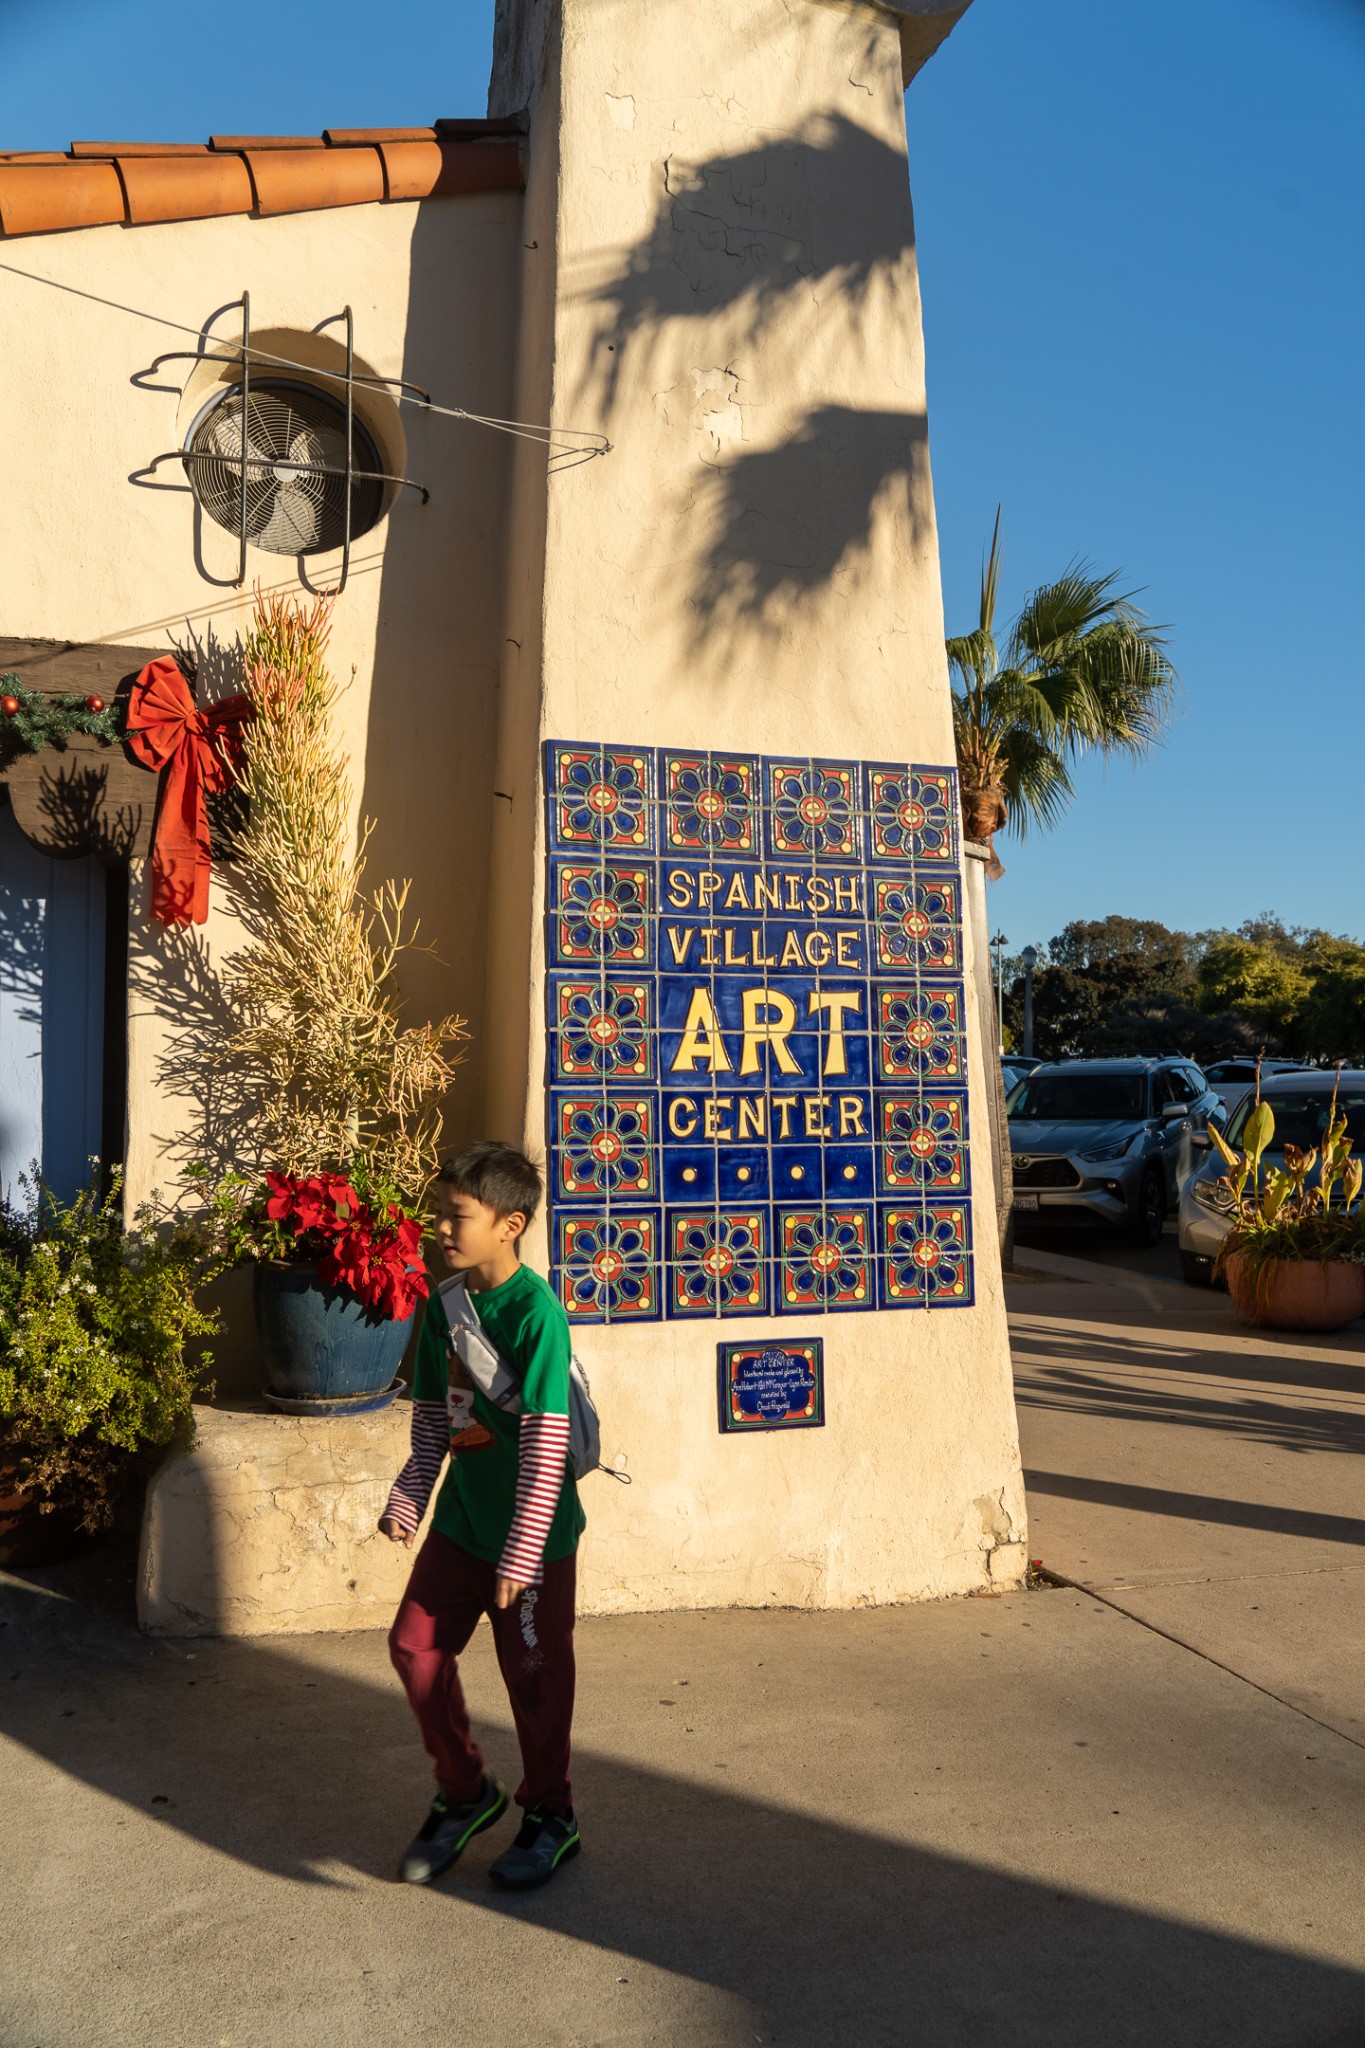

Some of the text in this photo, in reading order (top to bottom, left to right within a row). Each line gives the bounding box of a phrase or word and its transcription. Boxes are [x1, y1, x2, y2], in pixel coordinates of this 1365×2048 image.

[667, 869, 861, 913] SPANISH
[666, 925, 861, 970] VILLAGE
[669, 986, 862, 1077] ART
[668, 1094, 868, 1141] CENTER
[753, 1358, 794, 1369] ART CENTER
